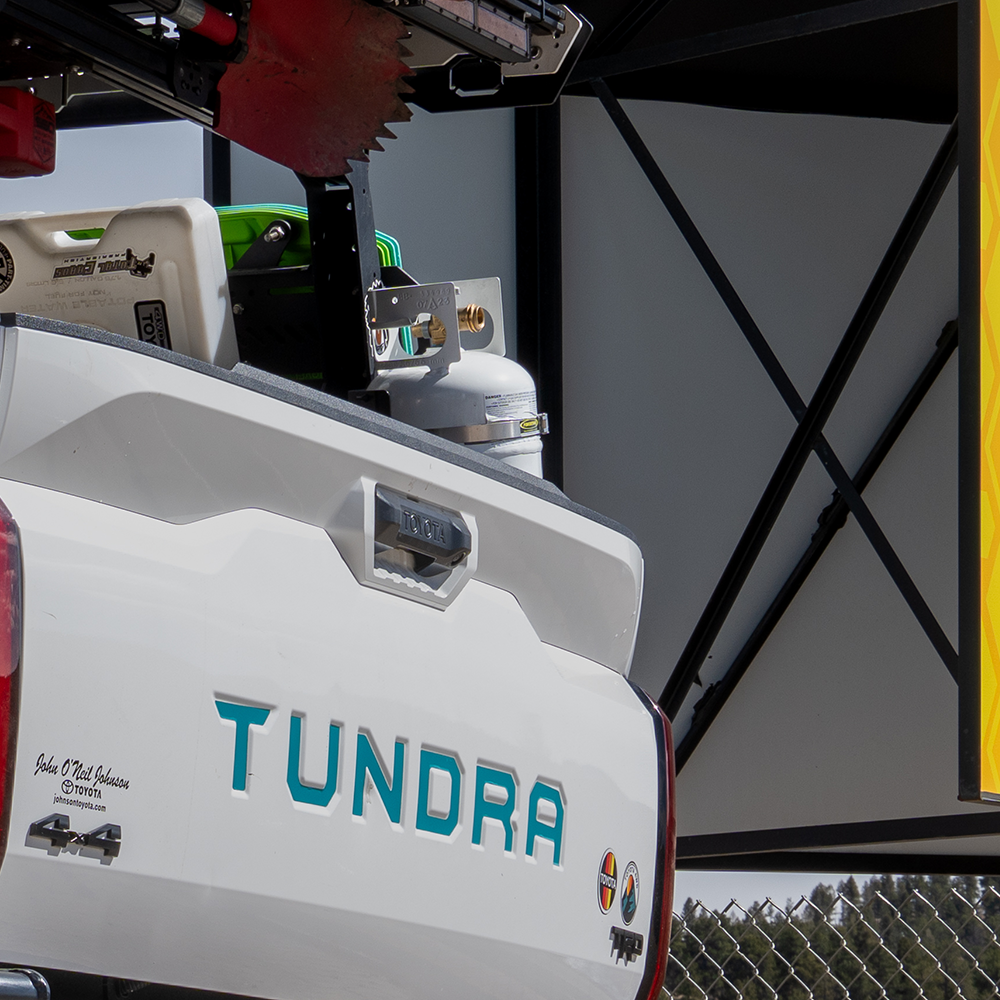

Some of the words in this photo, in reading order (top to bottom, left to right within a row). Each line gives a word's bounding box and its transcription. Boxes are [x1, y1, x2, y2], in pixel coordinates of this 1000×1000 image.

[20, 301, 68, 313] WATER
[403, 509, 446, 544] TOYOTA
[34, 753, 59, 776] John
[61, 758, 94, 781] O'Neil
[92, 765, 130, 790] Johnson
[213, 695, 566, 870] TUNDRA
[53, 793, 107, 812] johnsontoyota.com
[75, 784, 102, 799] TOYOTA
[609, 926, 644, 960] TRD
